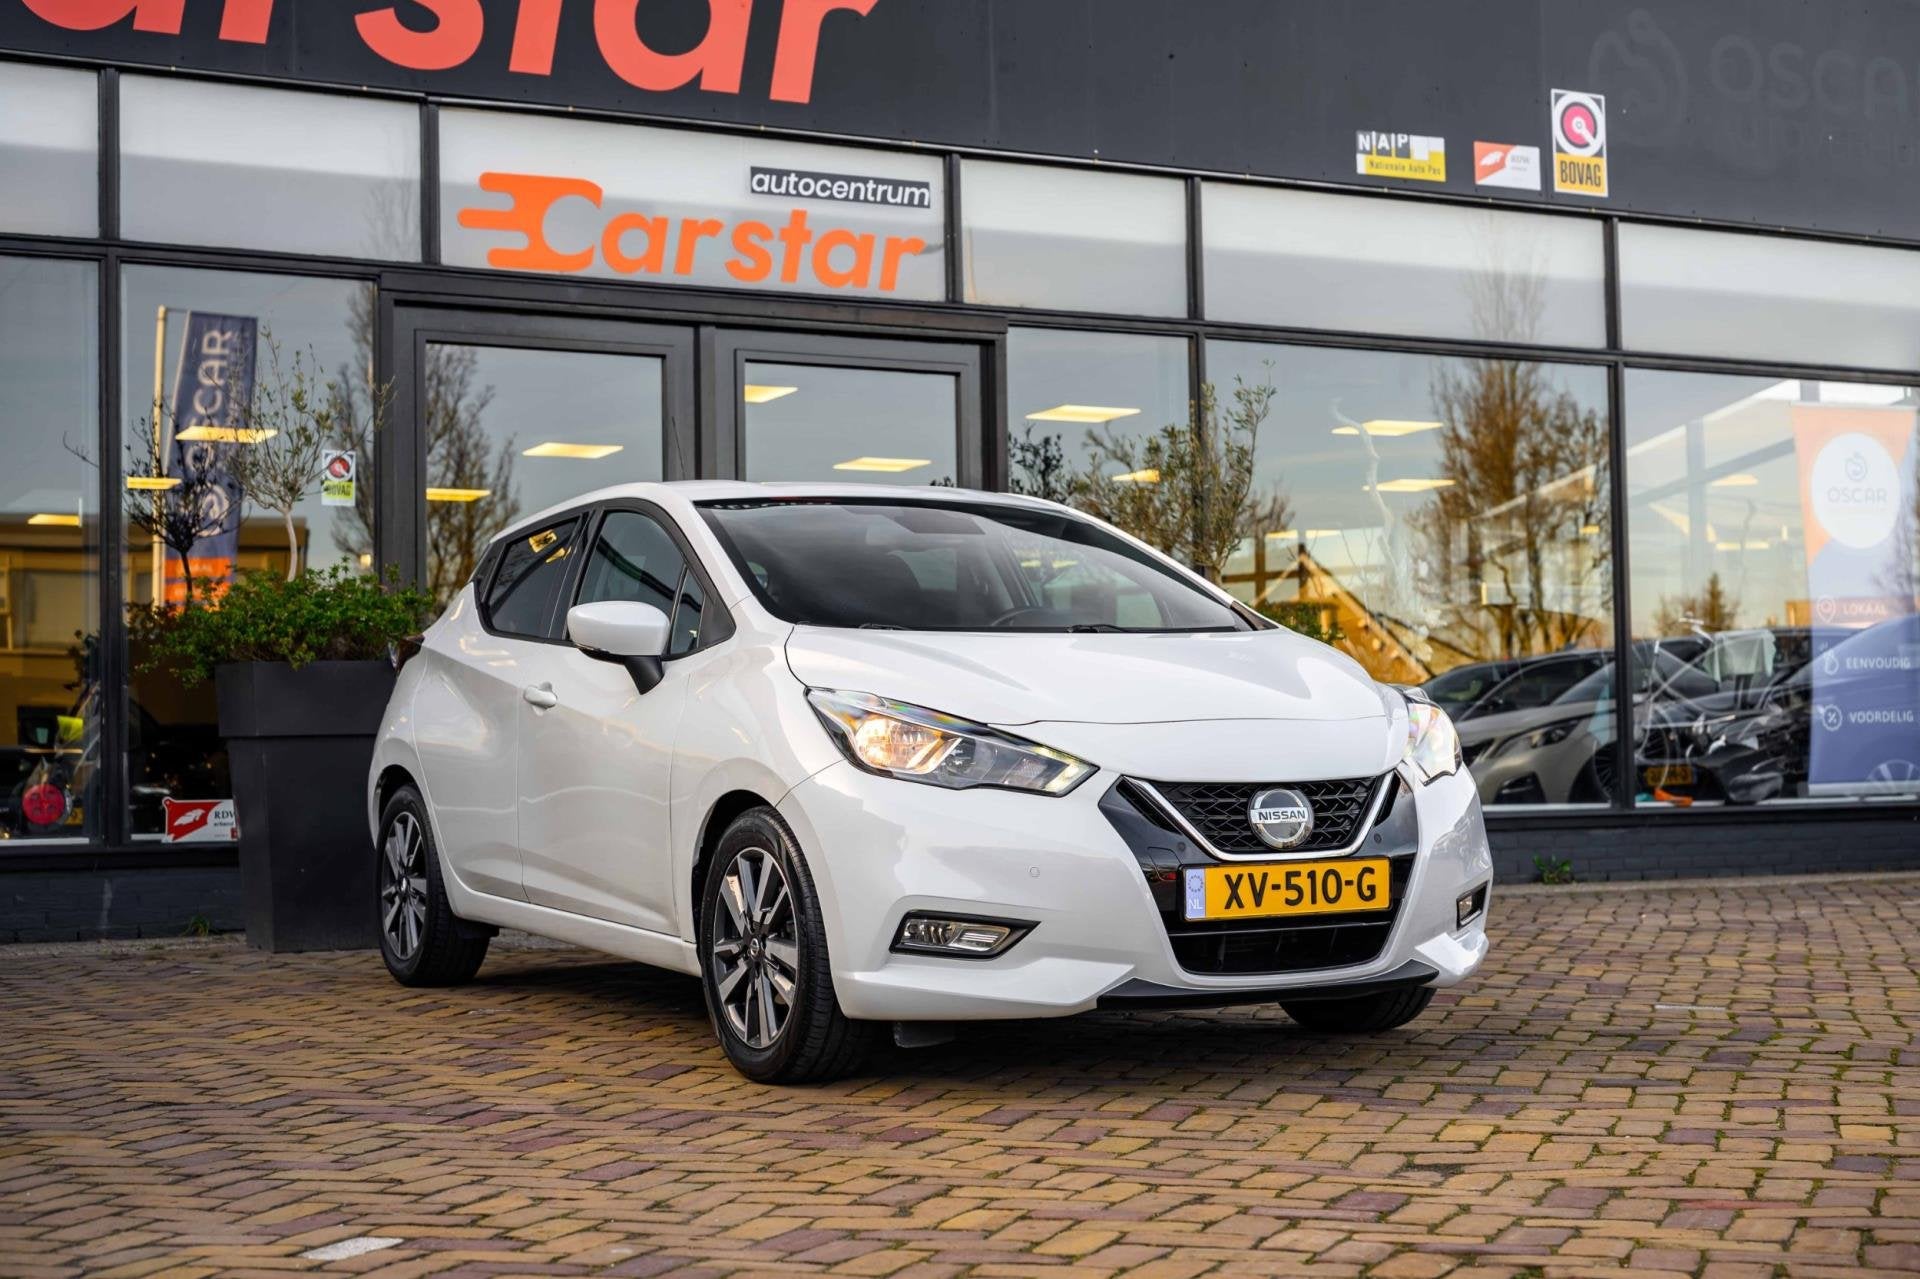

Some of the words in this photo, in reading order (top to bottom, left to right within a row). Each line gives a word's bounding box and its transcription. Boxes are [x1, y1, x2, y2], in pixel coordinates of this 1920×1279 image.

[1710, 34, 1920, 121] OSCA
[1560, 160, 1601, 187] BOVAG
[751, 170, 930, 206] autocentrum
[457, 172, 925, 292] Carstar
[1827, 486, 1888, 504] OSCAR
[1842, 604, 1888, 616] LOKAAL
[1846, 656, 1911, 670] EENVOUDIG
[1849, 710, 1914, 723] VOORDELIG
[1258, 809, 1306, 822] NISSAN
[1224, 866, 1376, 910] XV-510-G
[1188, 898, 1203, 910] NL
